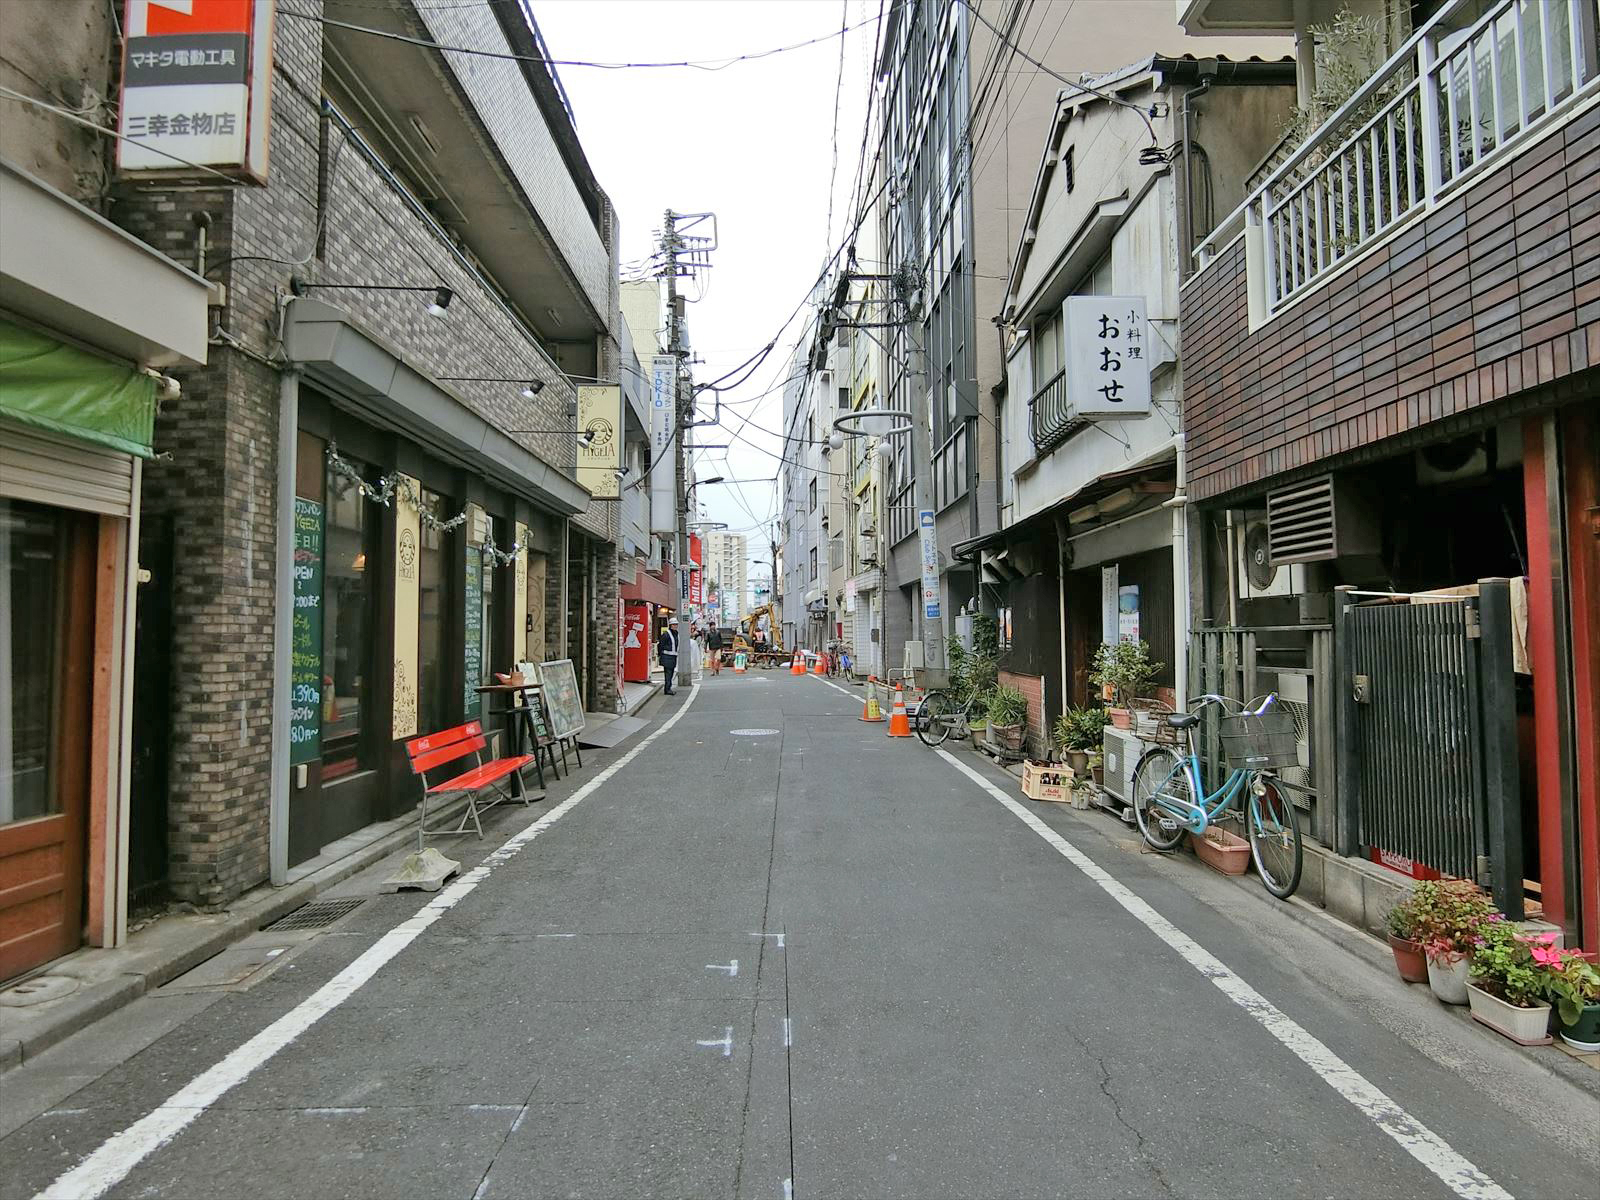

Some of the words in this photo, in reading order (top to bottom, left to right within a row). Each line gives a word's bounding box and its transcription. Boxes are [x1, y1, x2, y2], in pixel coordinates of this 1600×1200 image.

[131, 50, 236, 68] マキタ電動工具
[127, 113, 236, 138] 三幸金物店
[1126, 310, 1144, 360] 小料理
[1097, 313, 1125, 403] おおせ
[295, 513, 321, 532] YGEIA
[294, 566, 314, 580] PEN
